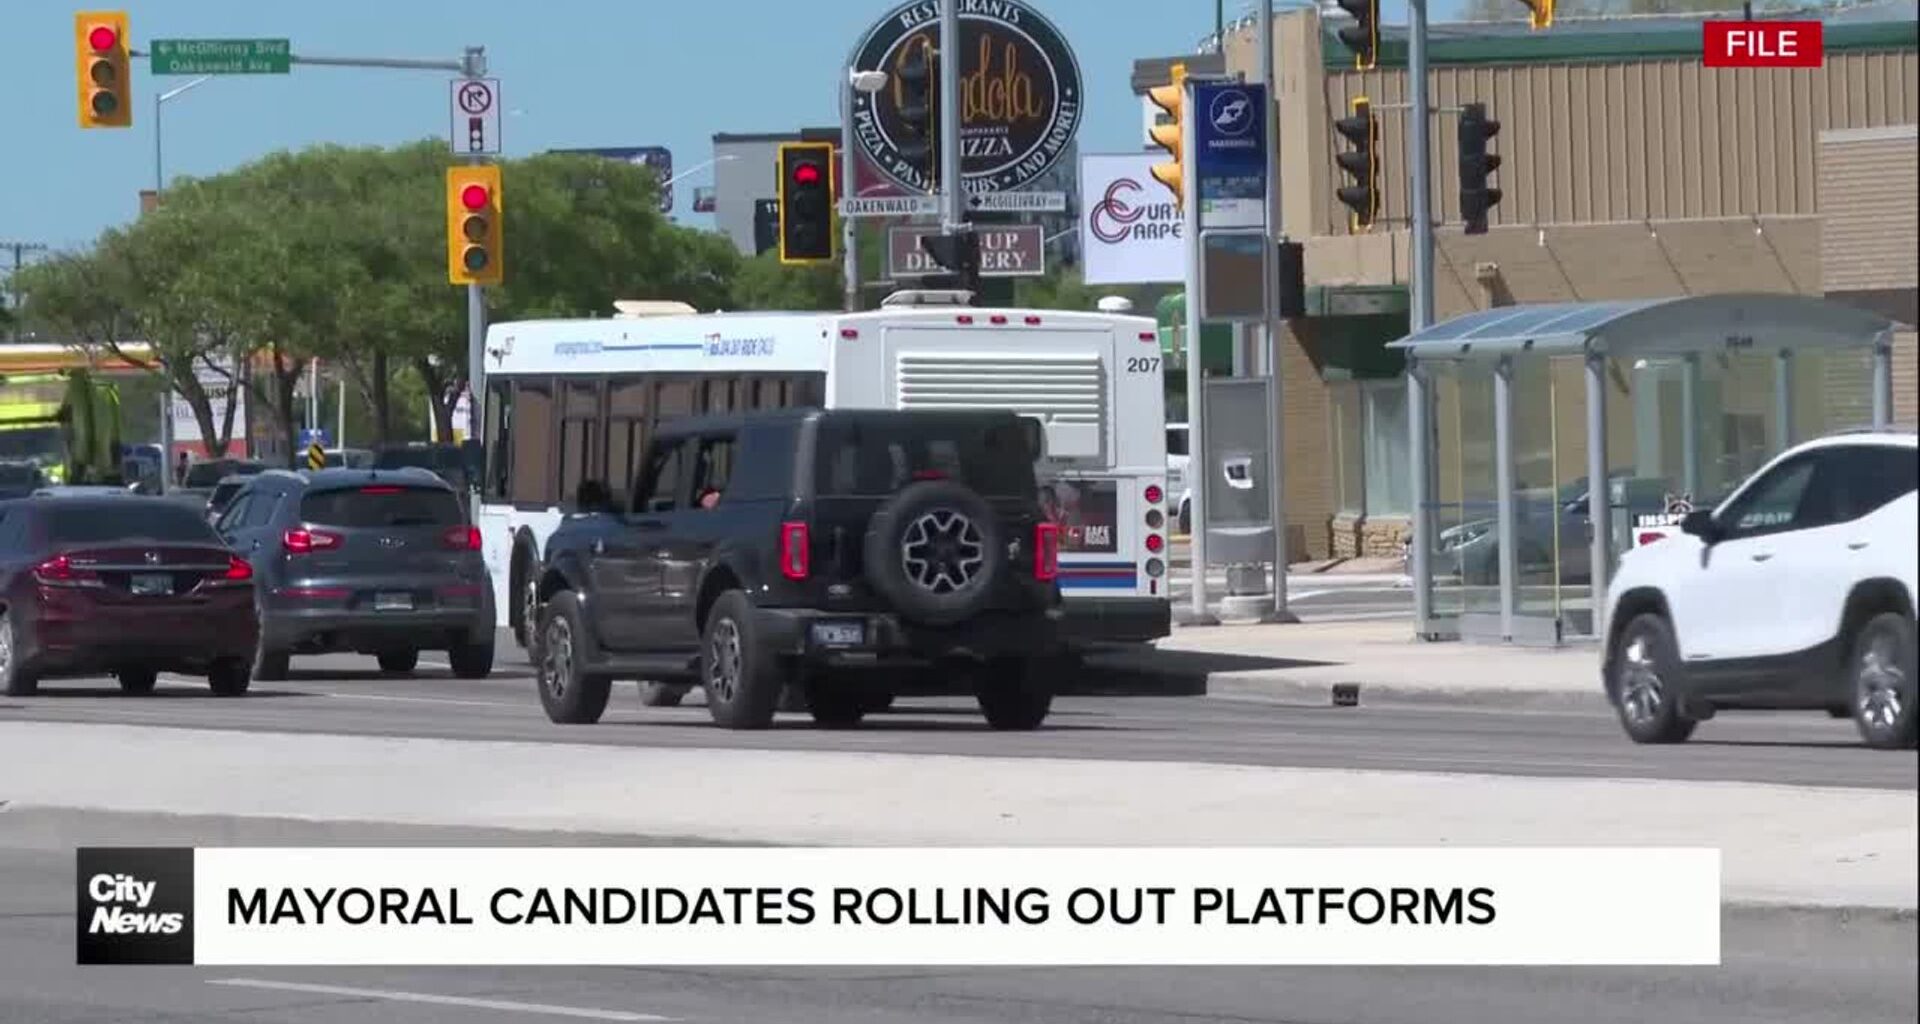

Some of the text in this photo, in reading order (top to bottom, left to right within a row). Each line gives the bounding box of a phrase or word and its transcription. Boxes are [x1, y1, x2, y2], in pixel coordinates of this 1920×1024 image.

[855, 110, 885, 156] PIZZA
[1015, 151, 1046, 182] AND
[1044, 101, 1077, 156] MORE!
[960, 137, 1013, 157] IZZA
[846, 200, 918, 213] OAKENWALD
[906, 251, 1027, 270] DEERY
[1127, 357, 1161, 373] 207
